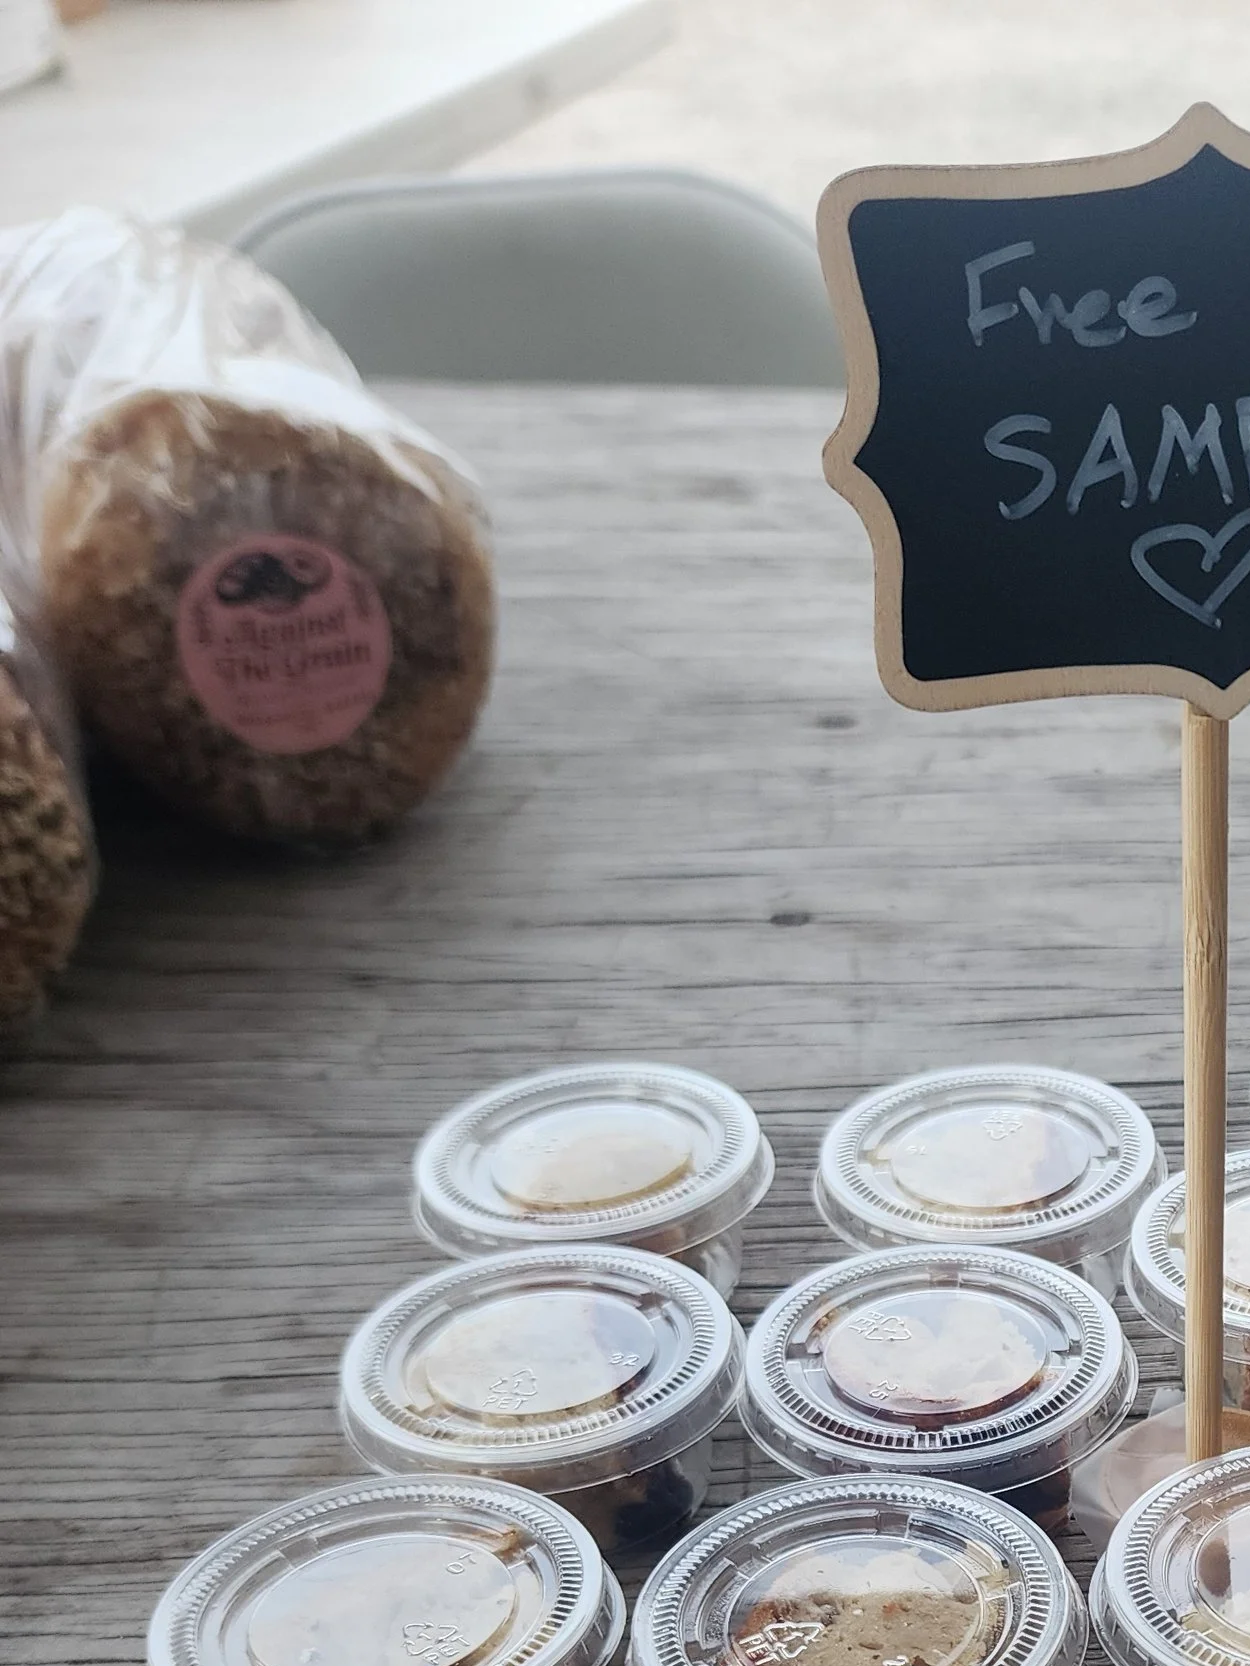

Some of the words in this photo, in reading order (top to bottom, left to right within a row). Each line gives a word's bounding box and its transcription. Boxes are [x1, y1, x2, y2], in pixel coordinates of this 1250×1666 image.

[965, 241, 1197, 347] Free
[608, 1352, 641, 1367] 32
[482, 1395, 530, 1411] PET
[868, 1379, 899, 1401] 25
[424, 1634, 471, 1665] PET
[738, 1632, 782, 1666] PET
